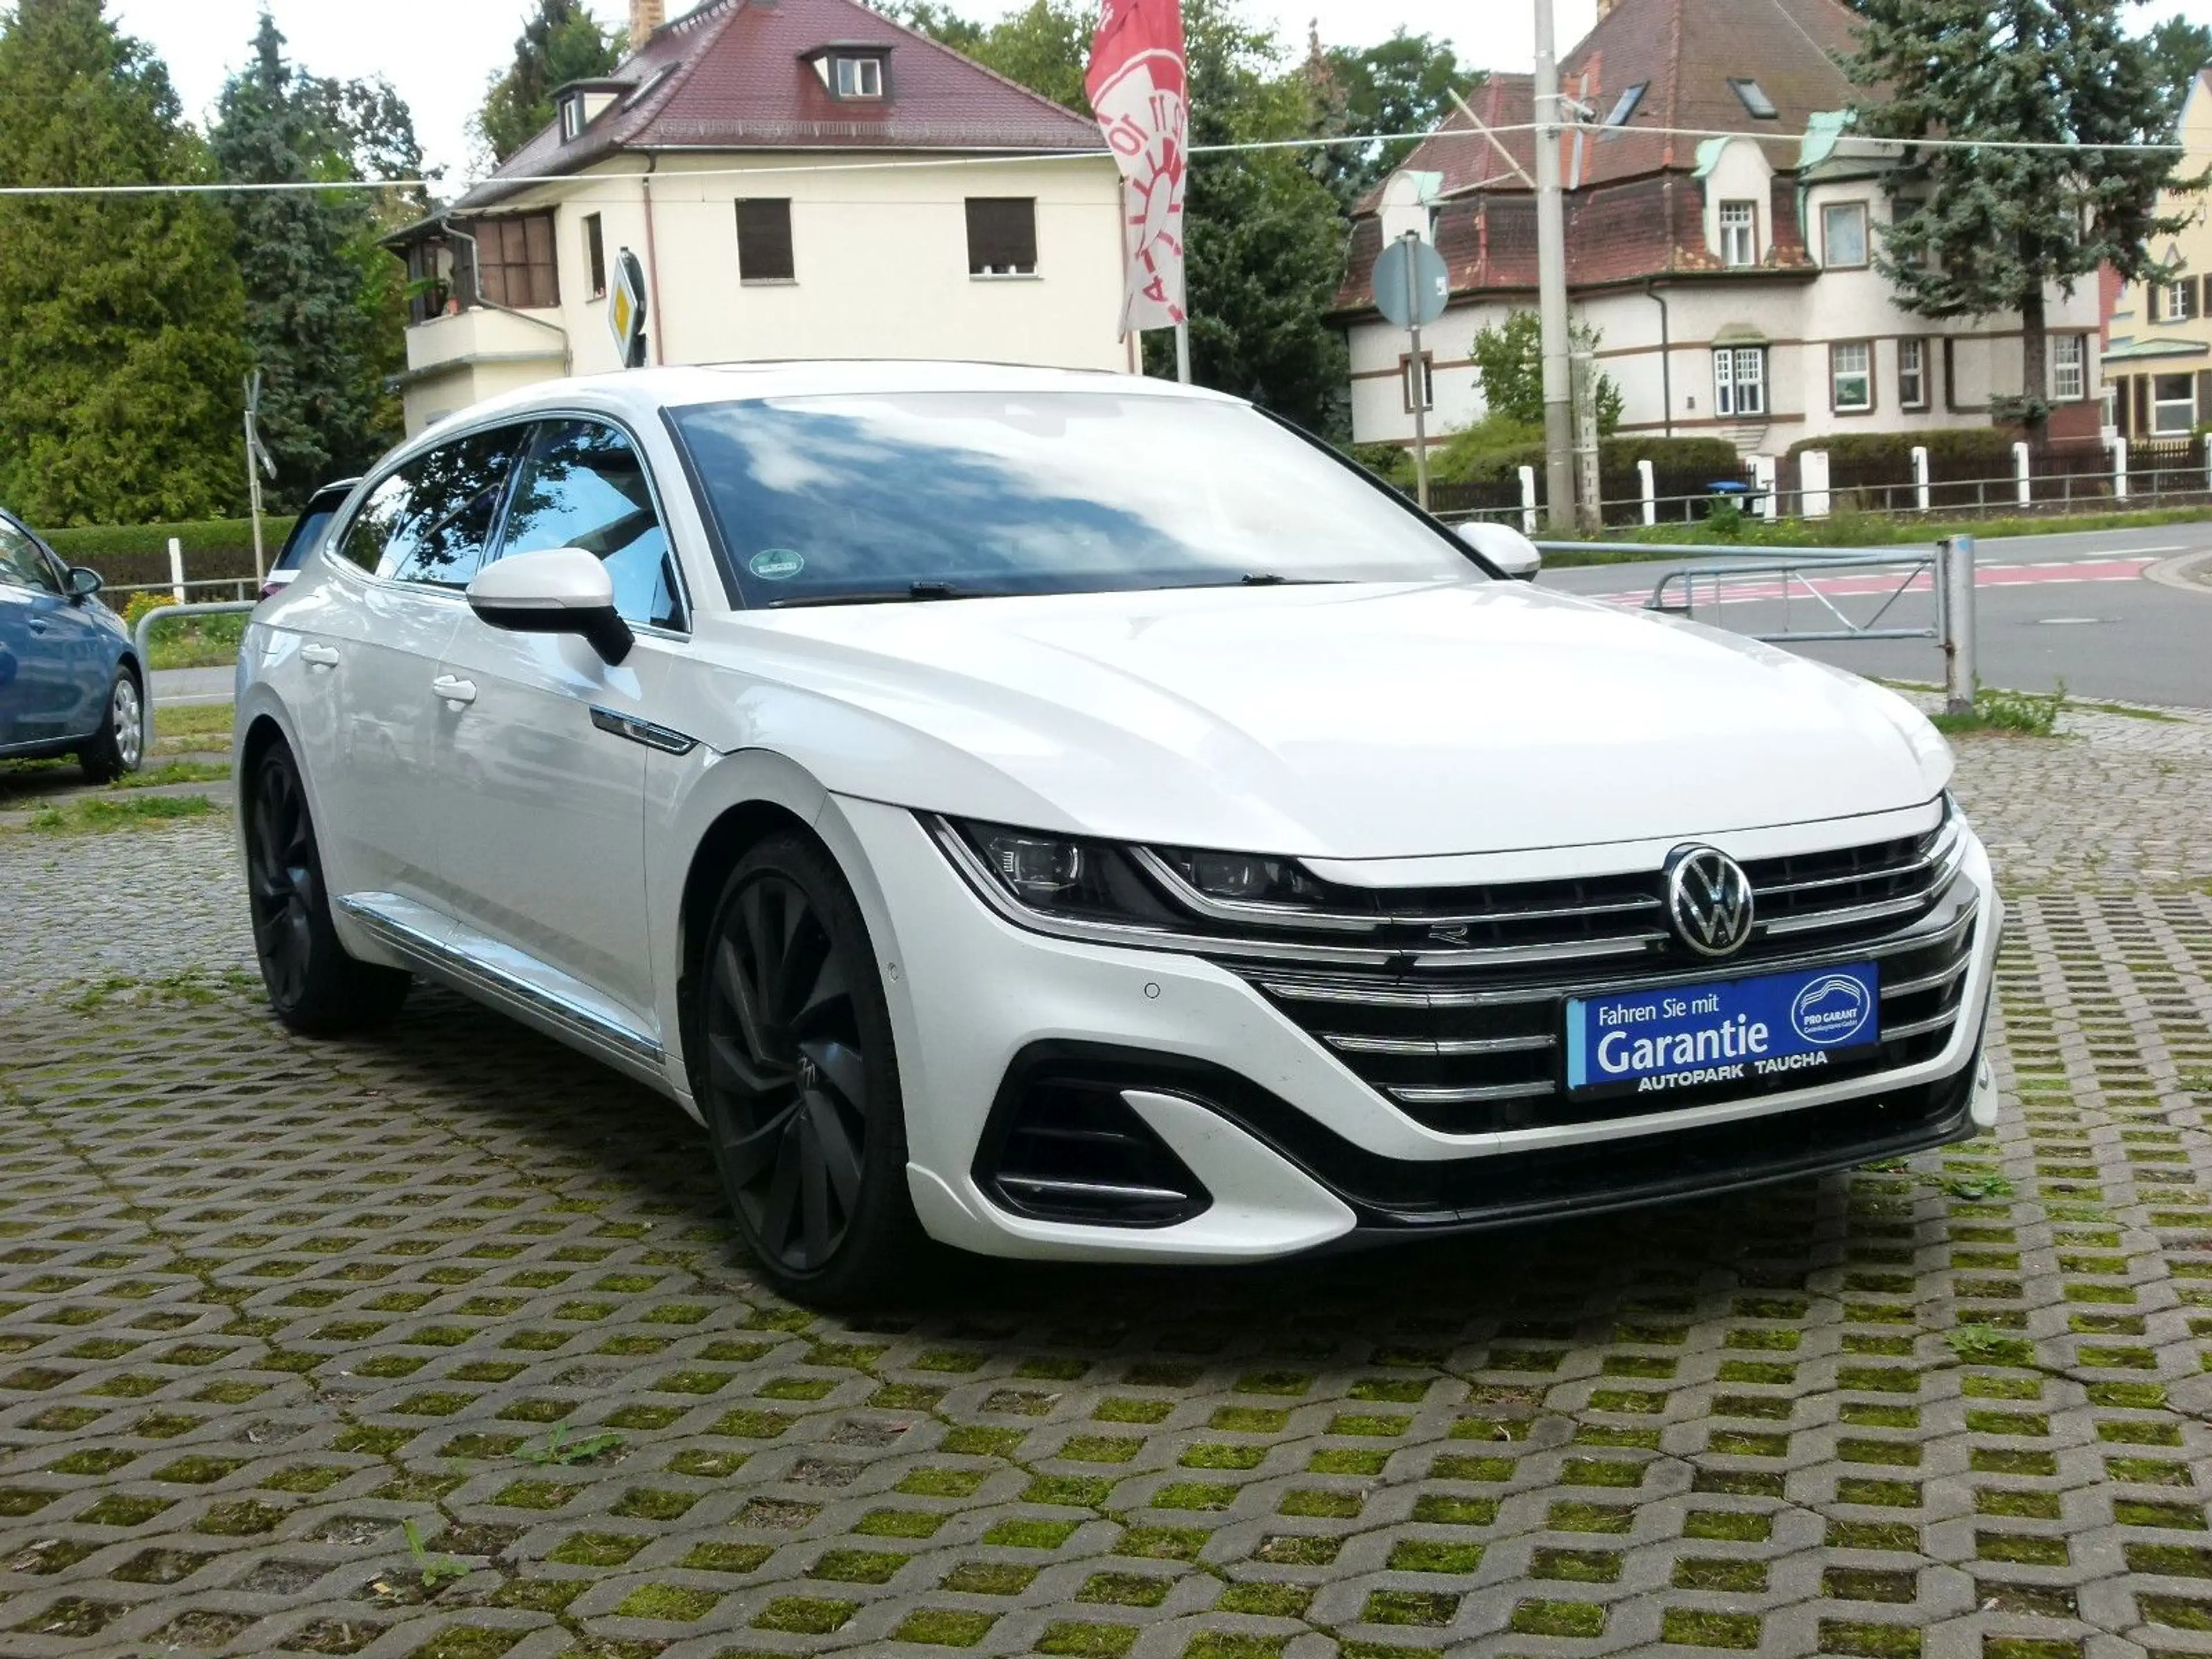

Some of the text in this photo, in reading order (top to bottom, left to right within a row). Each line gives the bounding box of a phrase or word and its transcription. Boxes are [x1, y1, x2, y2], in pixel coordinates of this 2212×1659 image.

[1672, 849, 1752, 953] VW
[1599, 994, 1719, 1025] Fahren Sie mit
[1804, 1009, 1857, 1025] PRO GARANT
[1598, 1014, 1768, 1073] Garantie
[1638, 1051, 1828, 1091] AUTOPARK TAUCHA
